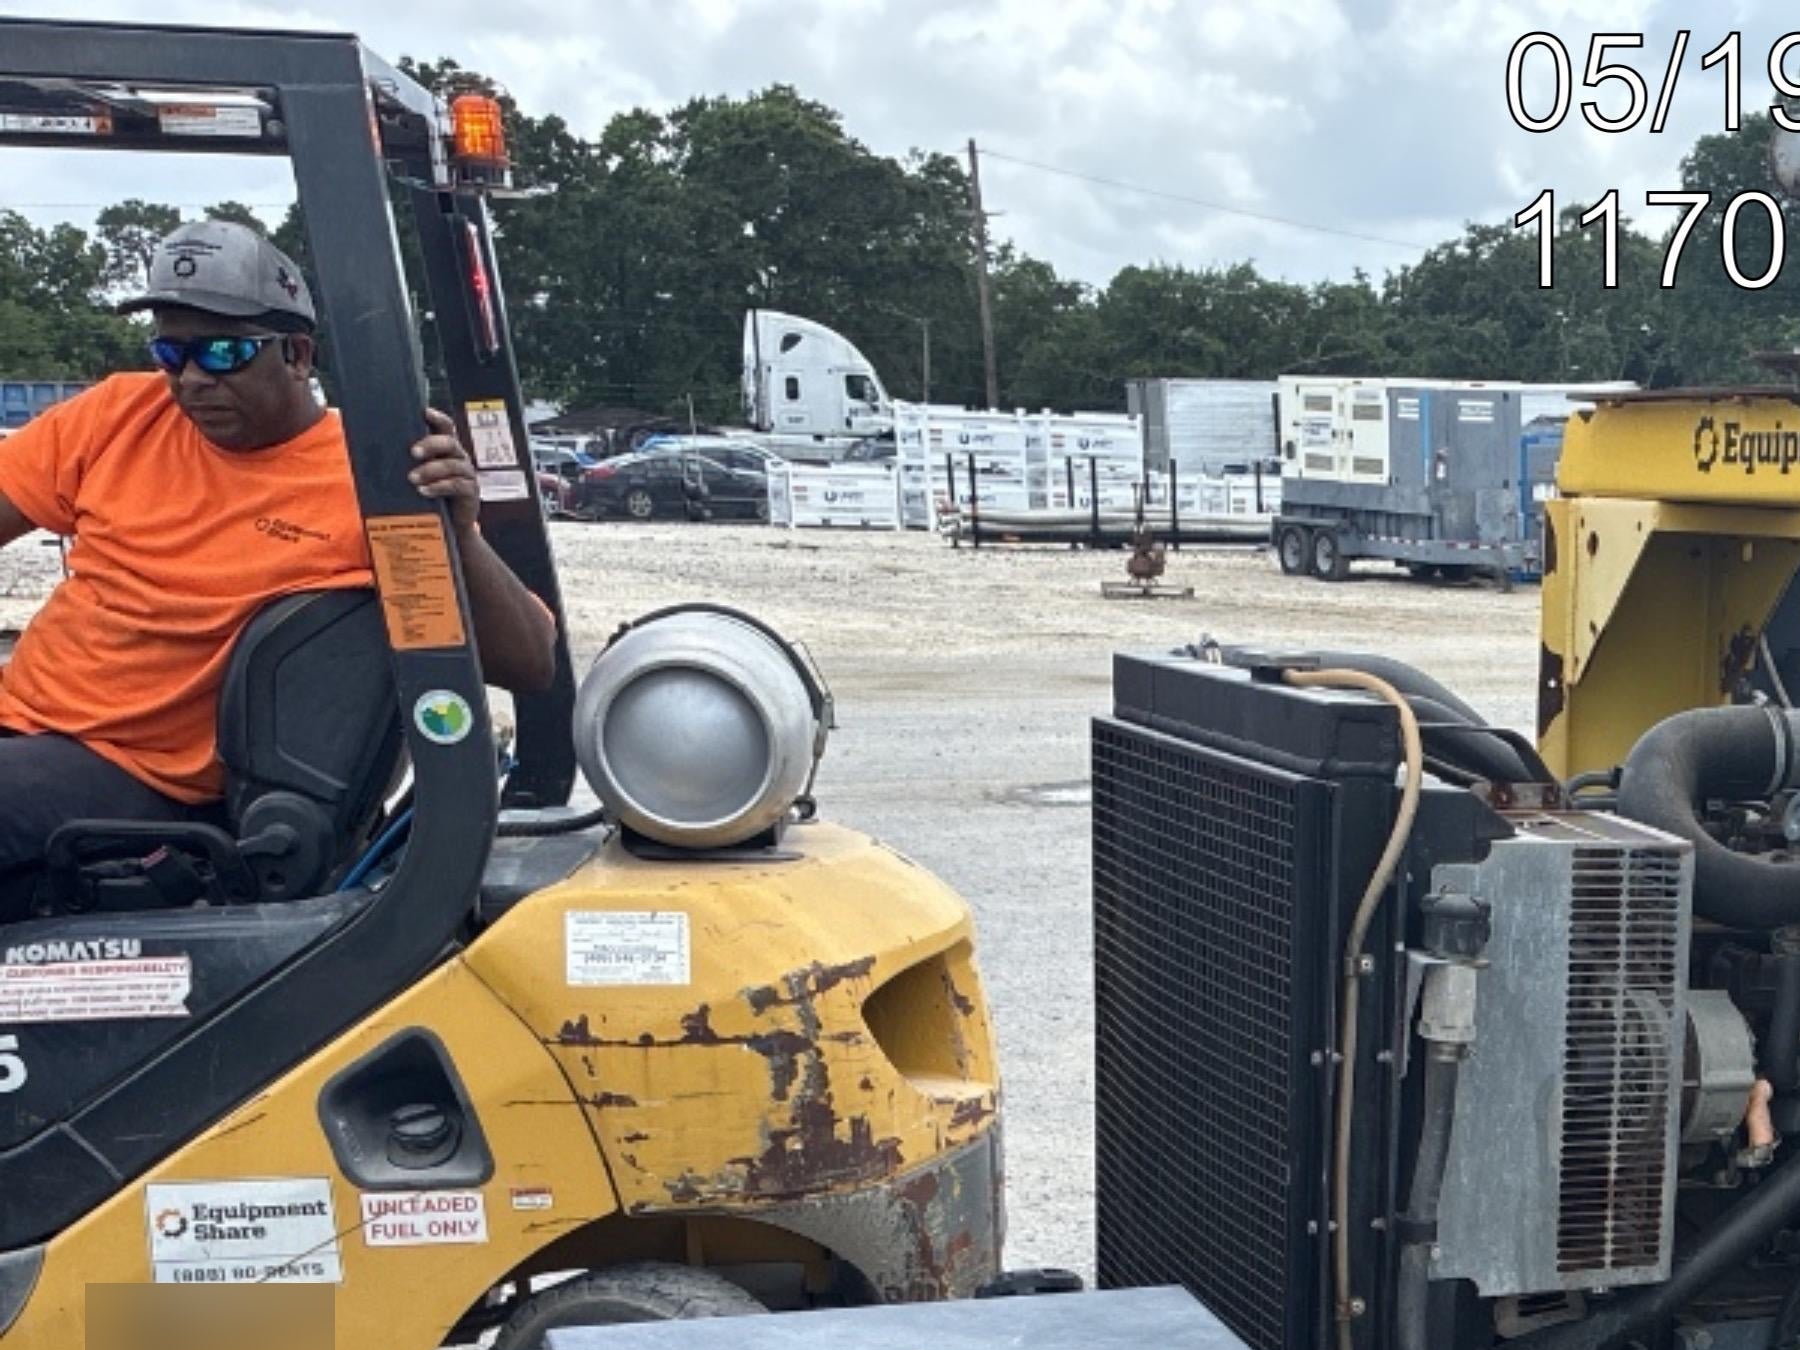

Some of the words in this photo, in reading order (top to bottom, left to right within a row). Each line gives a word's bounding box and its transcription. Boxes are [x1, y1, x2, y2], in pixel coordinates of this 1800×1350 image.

[5, 936, 143, 965] KOMATSU
[191, 1199, 328, 1224] Equipment
[367, 1195, 479, 1217] UNLEADED
[194, 1223, 267, 1242] Share
[371, 1222, 423, 1240] FUEL
[427, 1219, 481, 1237] ONLY
